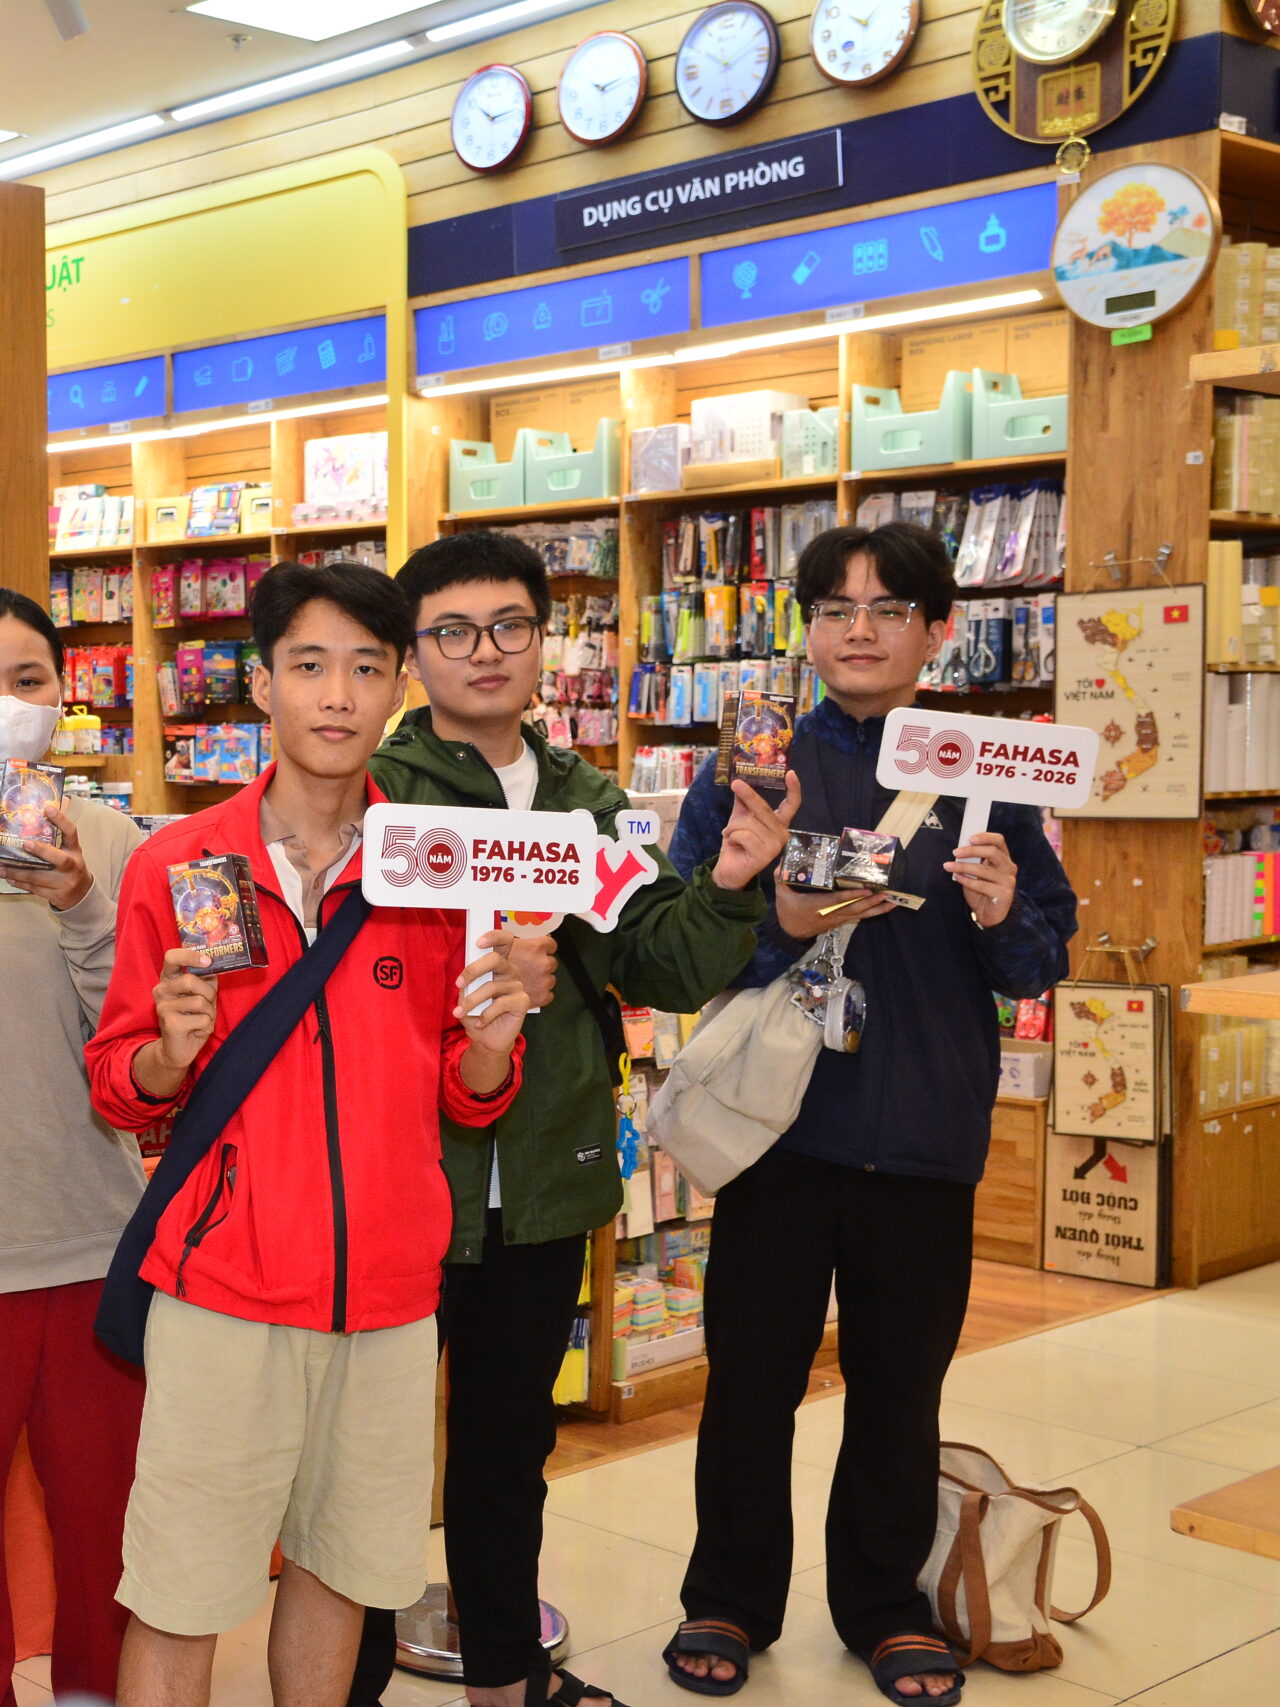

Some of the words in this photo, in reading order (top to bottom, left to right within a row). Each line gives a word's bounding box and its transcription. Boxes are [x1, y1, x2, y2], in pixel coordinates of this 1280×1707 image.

[842, 61, 851, 74] 7
[582, 195, 642, 227] DỤNG
[645, 188, 673, 213] CỤ
[676, 176, 721, 204] VĂN
[724, 156, 805, 193] PHÒNG
[45, 255, 84, 292] UẬT
[1077, 677, 1093, 689] TÔI
[1065, 688, 1087, 701] VIỆT
[1090, 690, 1115, 700] NAM
[894, 724, 975, 779] 50
[979, 741, 1080, 768] FAHASA
[938, 747, 961, 760] NĂM
[735, 765, 786, 778] TRANSFORMERS
[976, 762, 1016, 779] 1976
[1032, 768, 1077, 785] 2026
[628, 821, 651, 834] TM
[381, 825, 468, 889] 50
[472, 839, 580, 864] FAHASA
[429, 852, 452, 864] NĂM
[471, 866, 515, 883] 1976
[533, 868, 580, 885] 2026
[197, 942, 244, 957] NSFORMERS
[379, 965, 398, 981] SF
[1096, 1191, 1138, 1211] CUỘC
[1055, 1225, 1100, 1245] QUEN
[1104, 1233, 1145, 1251] THÓI
